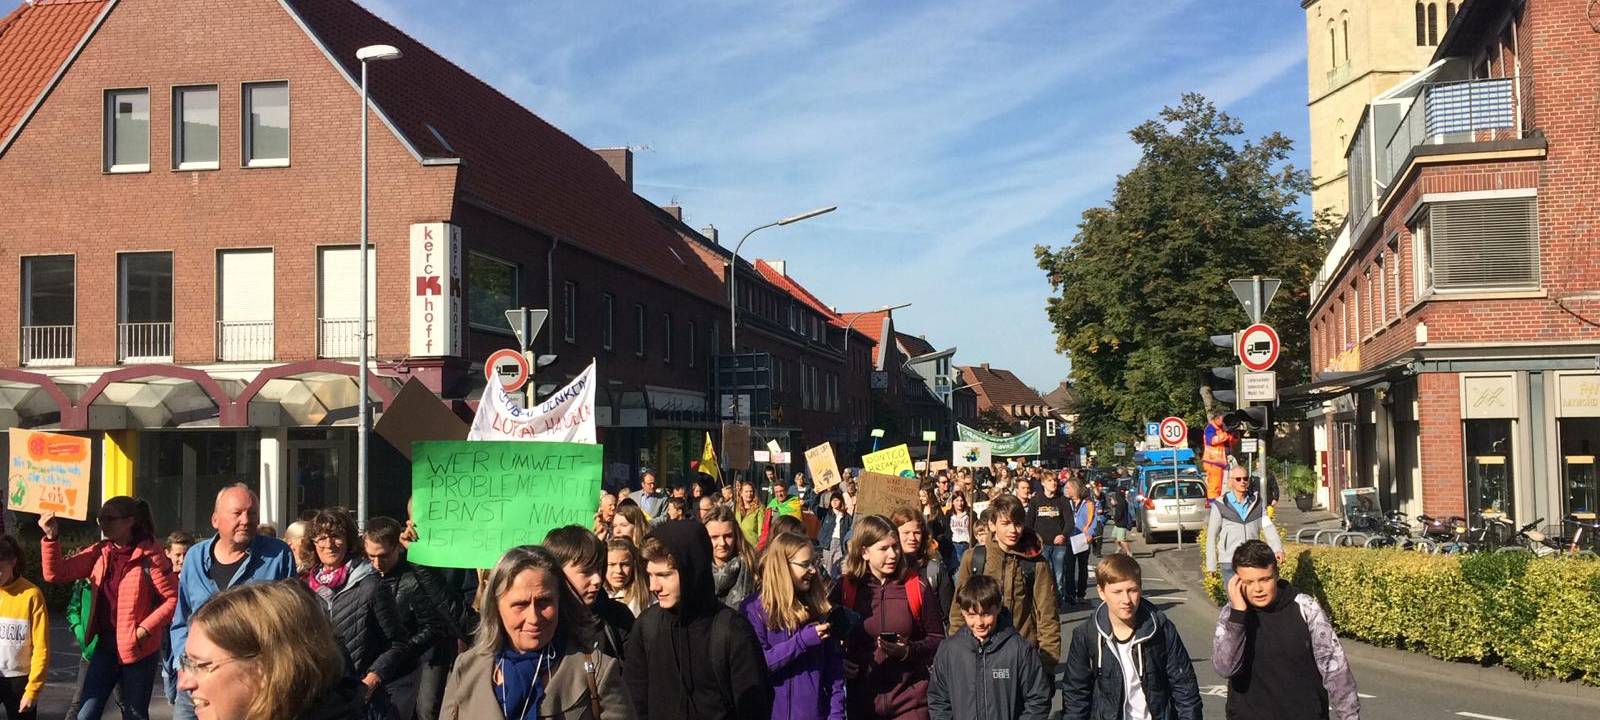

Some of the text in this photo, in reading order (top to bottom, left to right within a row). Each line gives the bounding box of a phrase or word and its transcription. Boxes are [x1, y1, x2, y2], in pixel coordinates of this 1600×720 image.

[1165, 425, 1180, 438] 30
[427, 451, 593, 475] WER UMWELT-
[427, 473, 541, 498] PROBLEME
[428, 499, 594, 526] ERNST NIMMT
[427, 527, 467, 547] IST
